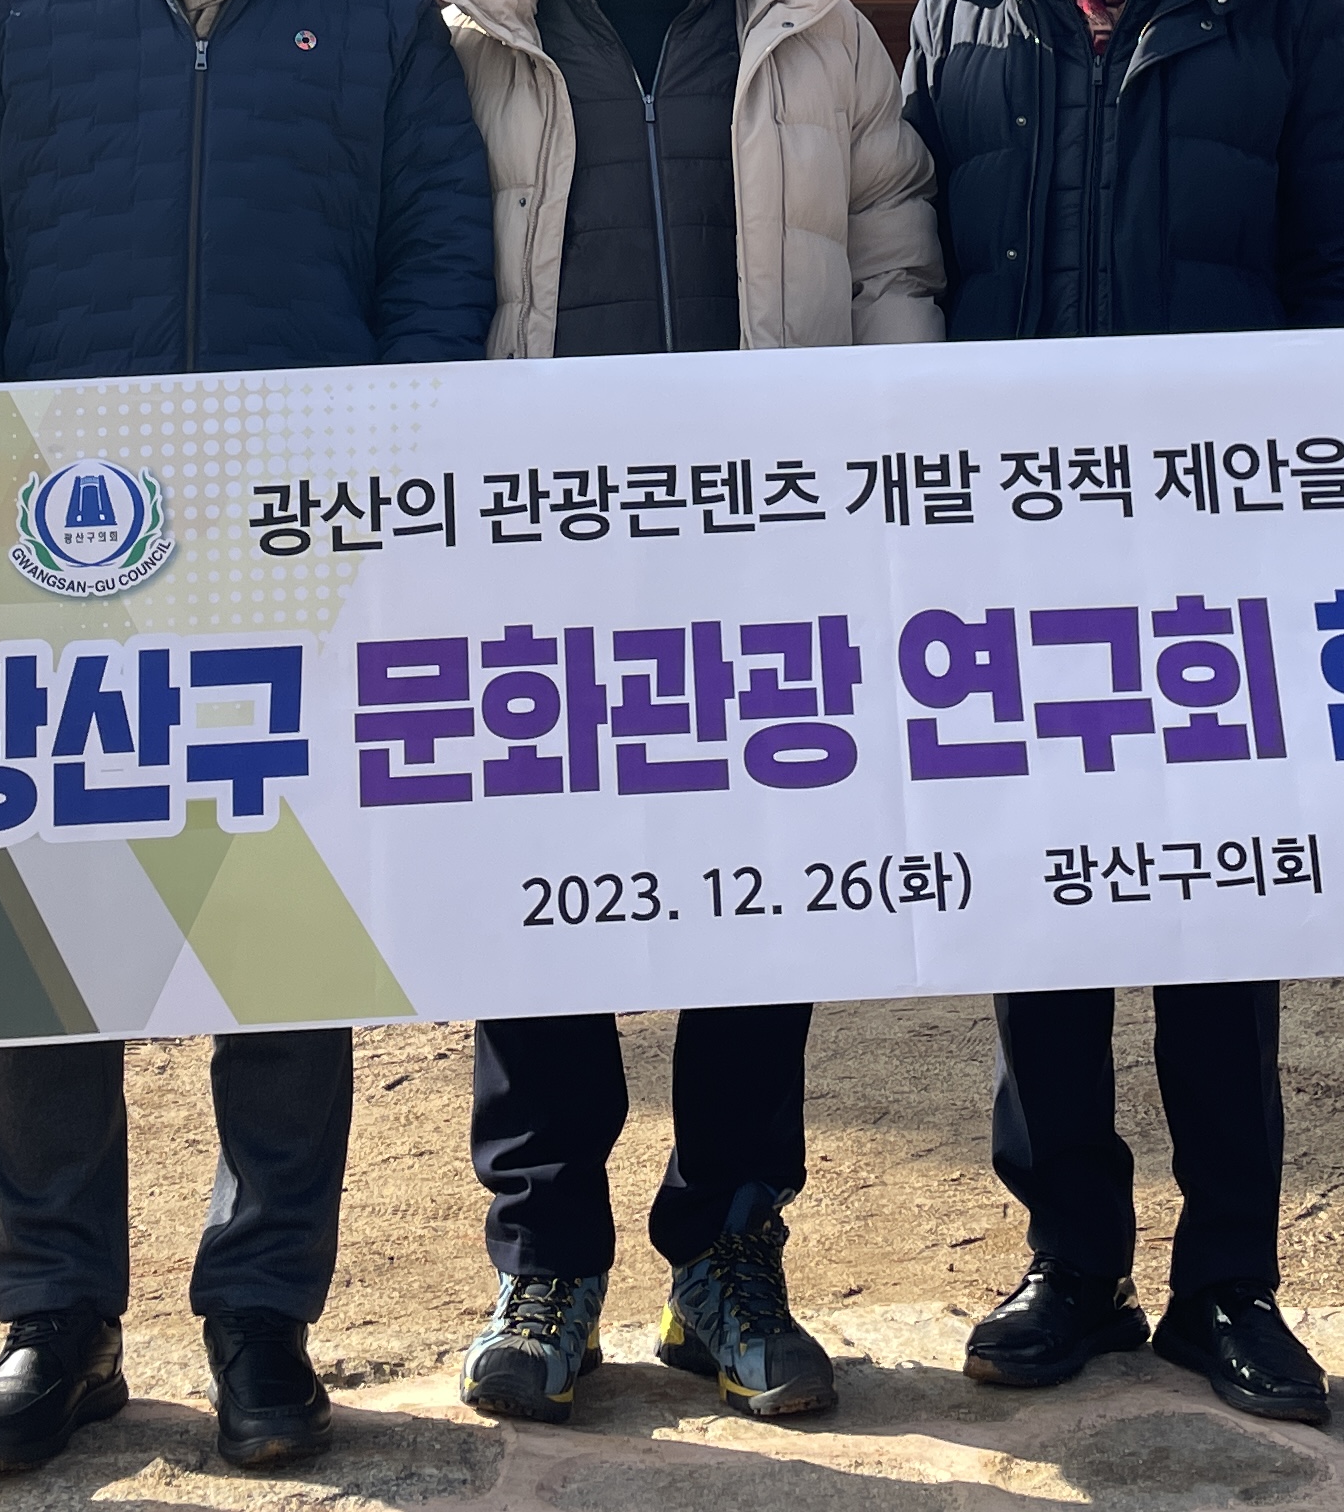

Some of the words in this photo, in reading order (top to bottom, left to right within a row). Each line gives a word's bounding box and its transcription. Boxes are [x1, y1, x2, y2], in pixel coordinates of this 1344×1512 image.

[248, 471, 456, 557] 광산의
[479, 458, 827, 544] 관광콘텐츠
[845, 449, 981, 526] 개발
[999, 444, 1134, 522] 정책
[11, 547, 116, 593] GWANGSAN-GU
[118, 540, 172, 586] COUNCIL
[354, 615, 862, 808] 문화관광
[898, 595, 1287, 780] 연구회
[522, 871, 680, 927] 2023.
[701, 866, 784, 918] 12.
[804, 850, 973, 914] 26(화)
[1044, 833, 1324, 906] 광산구의회
